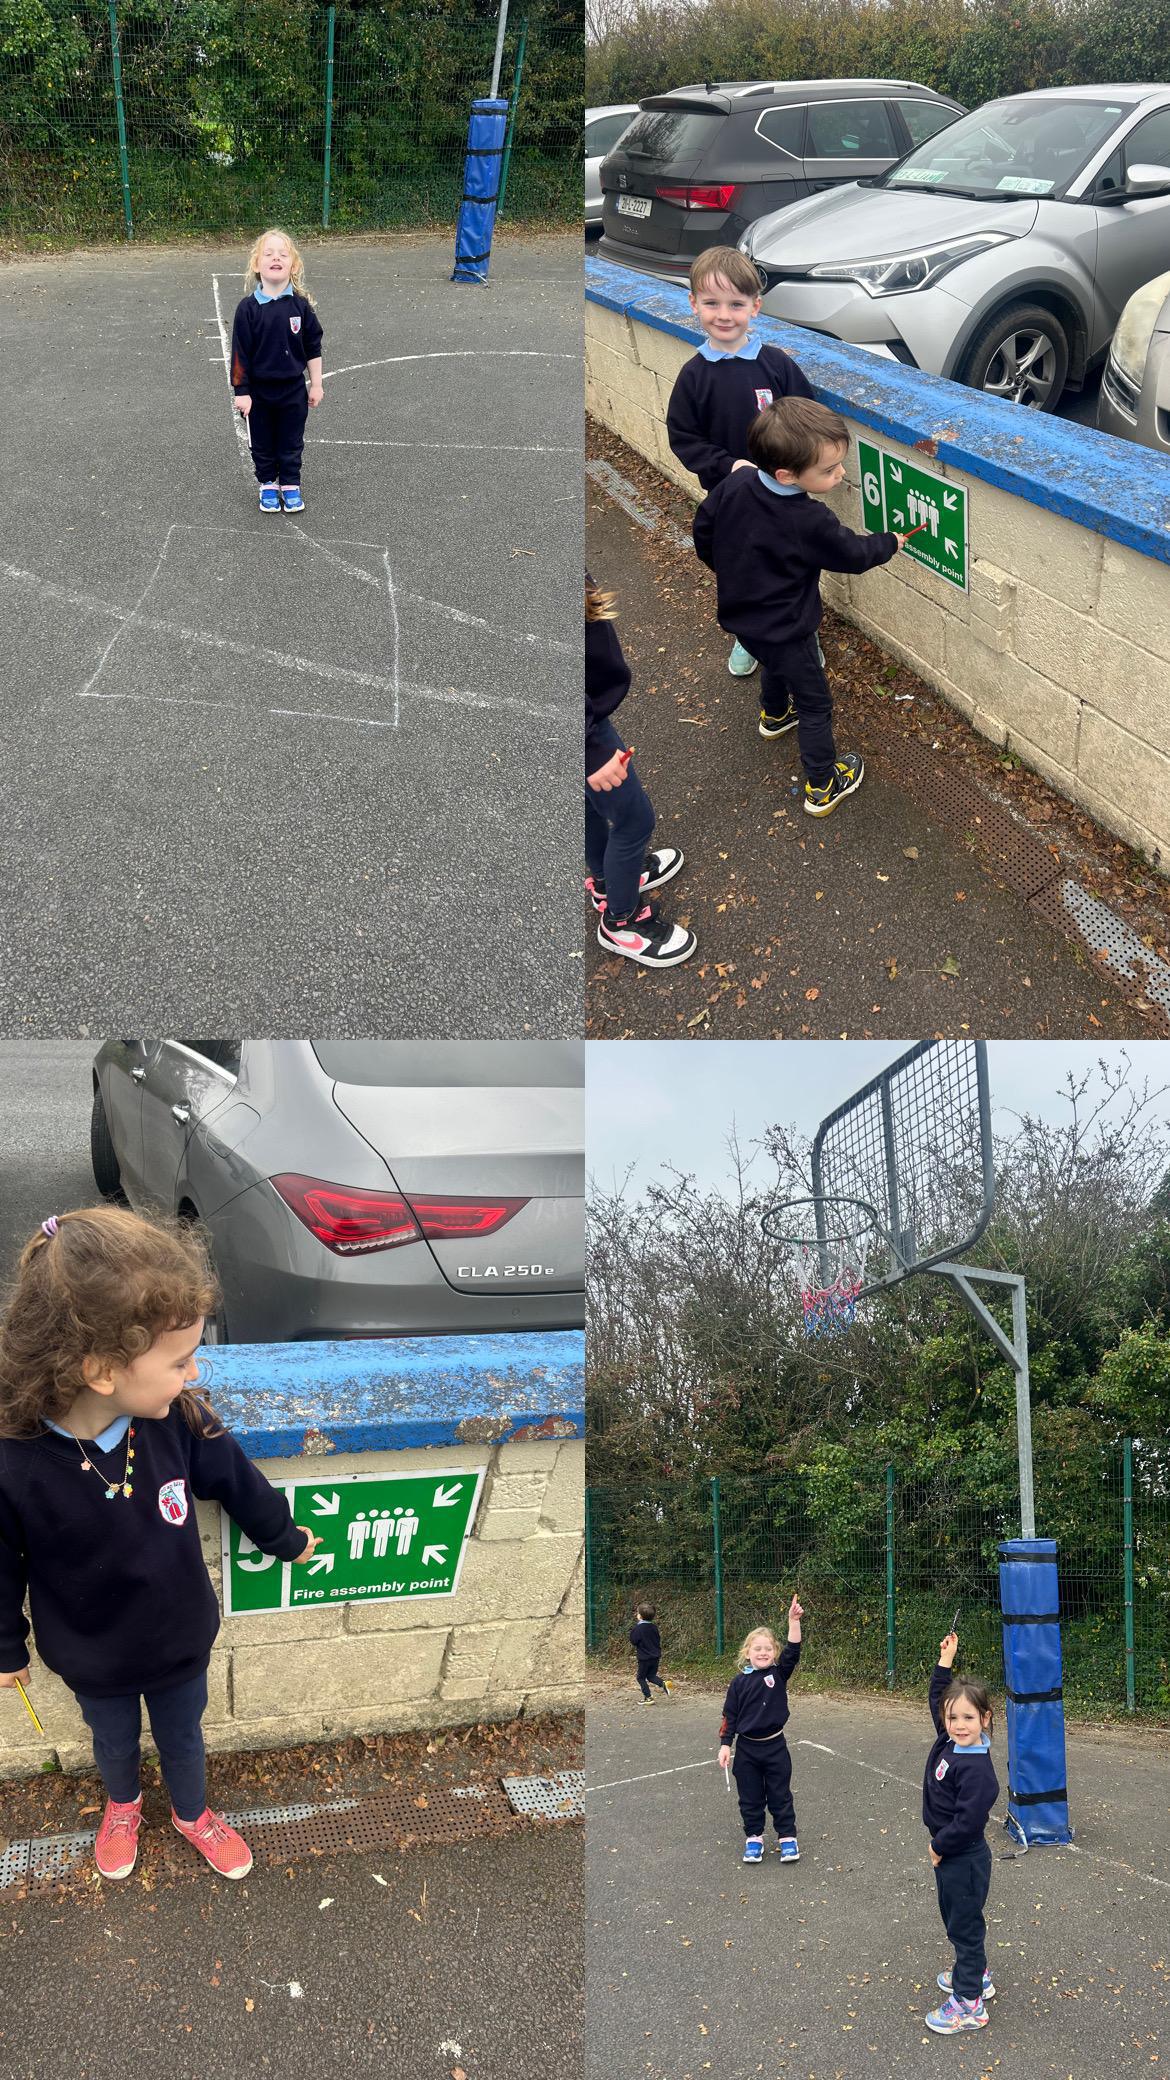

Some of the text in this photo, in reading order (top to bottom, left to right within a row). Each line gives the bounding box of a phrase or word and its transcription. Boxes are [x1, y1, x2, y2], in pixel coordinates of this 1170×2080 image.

[863, 471, 881, 507] 6
[904, 542, 964, 582] assembly point
[457, 1264, 555, 1278] CLA 250e
[236, 1530, 277, 1572] 5
[293, 1577, 450, 1600] Fire assembly point
